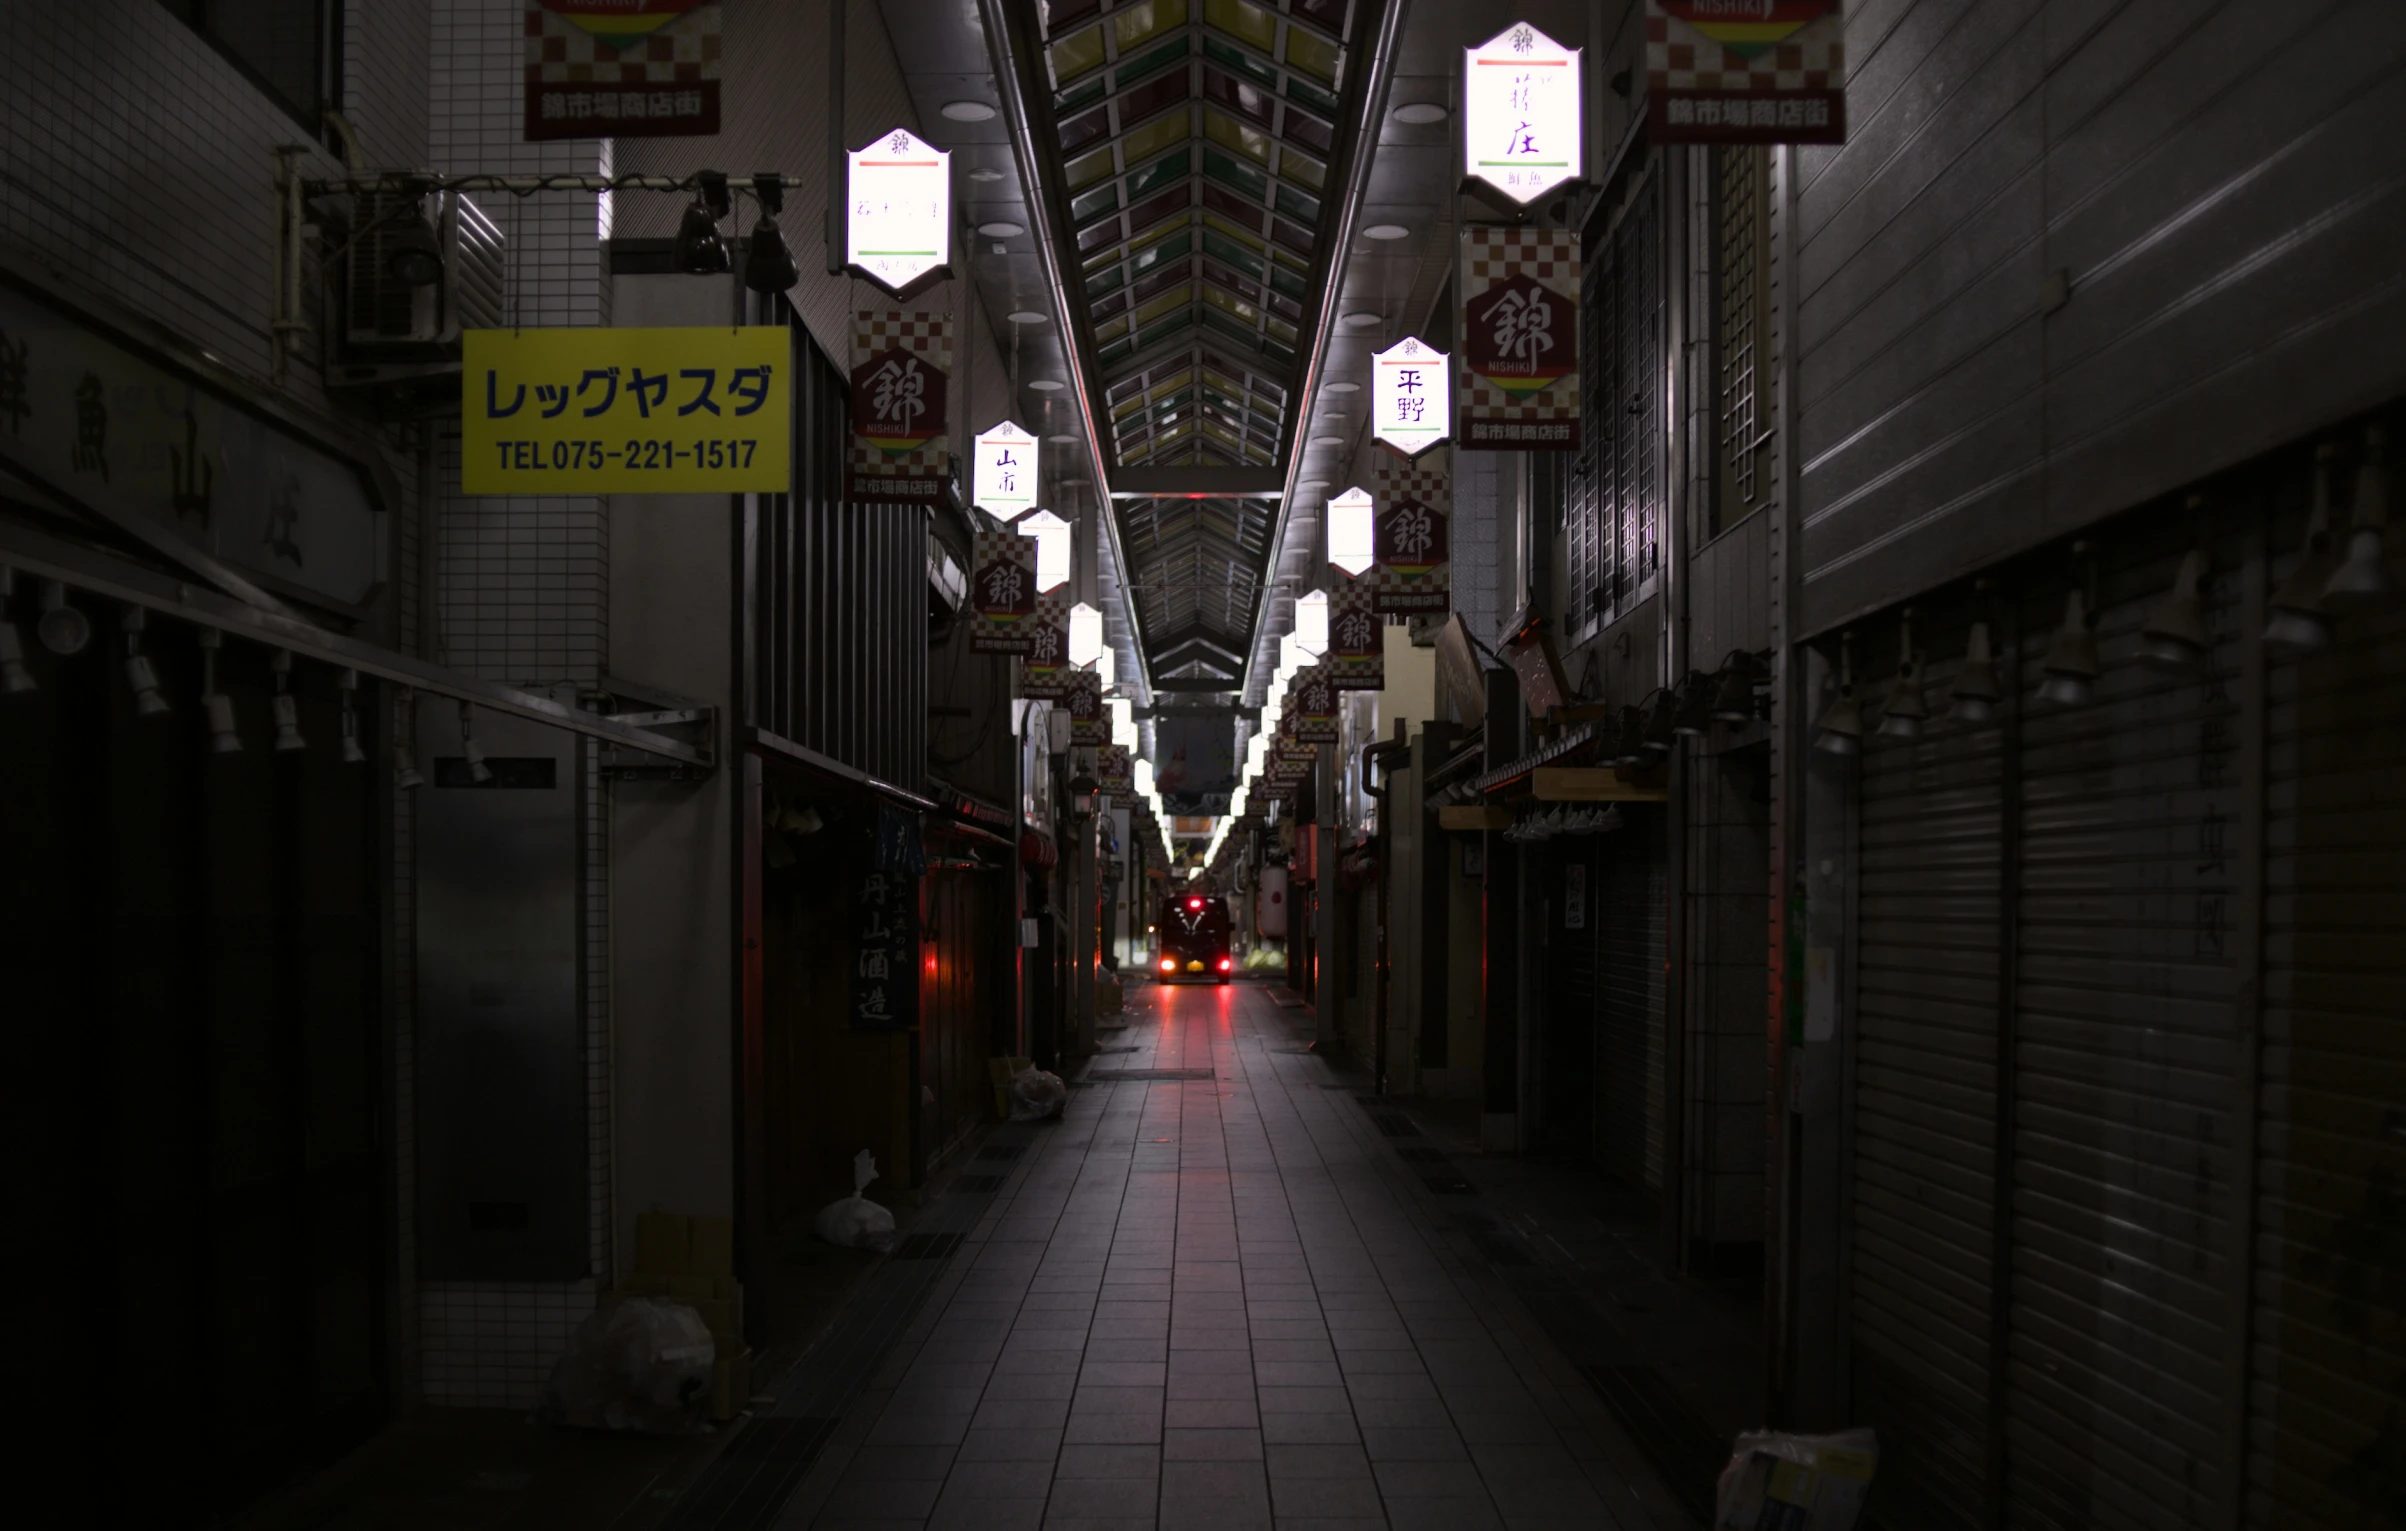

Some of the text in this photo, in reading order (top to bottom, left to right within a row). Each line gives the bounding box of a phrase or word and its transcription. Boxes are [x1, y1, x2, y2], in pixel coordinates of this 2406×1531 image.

[1508, 28, 1533, 56] 錦
[541, 91, 702, 119] 錦市場商店街
[1666, 98, 1830, 127] 錦市場商店街
[887, 133, 909, 157] 錦
[1480, 286, 1555, 376] 錦
[1402, 340, 1418, 358] 錦
[1488, 360, 1530, 373] NISHIKI
[486, 365, 773, 419] レッグヤスダ
[861, 357, 926, 437] 錦
[1397, 369, 1425, 422] 平野
[866, 423, 904, 434] NISHIKI
[1471, 423, 1570, 440] 錦市場商店街
[853, 478, 938, 495] 錦市場商店街
[996, 449, 1017, 493] 山市
[1385, 506, 1432, 564] 錦
[1389, 556, 1417, 564] NISHIKI
[982, 564, 1023, 614] 錦
[1032, 626, 1058, 667] 錦
[1336, 612, 1372, 655] 錦
[1068, 689, 1094, 721] 錦
[1303, 685, 1330, 717] 錦
[855, 873, 894, 1021] 丹山酒造
